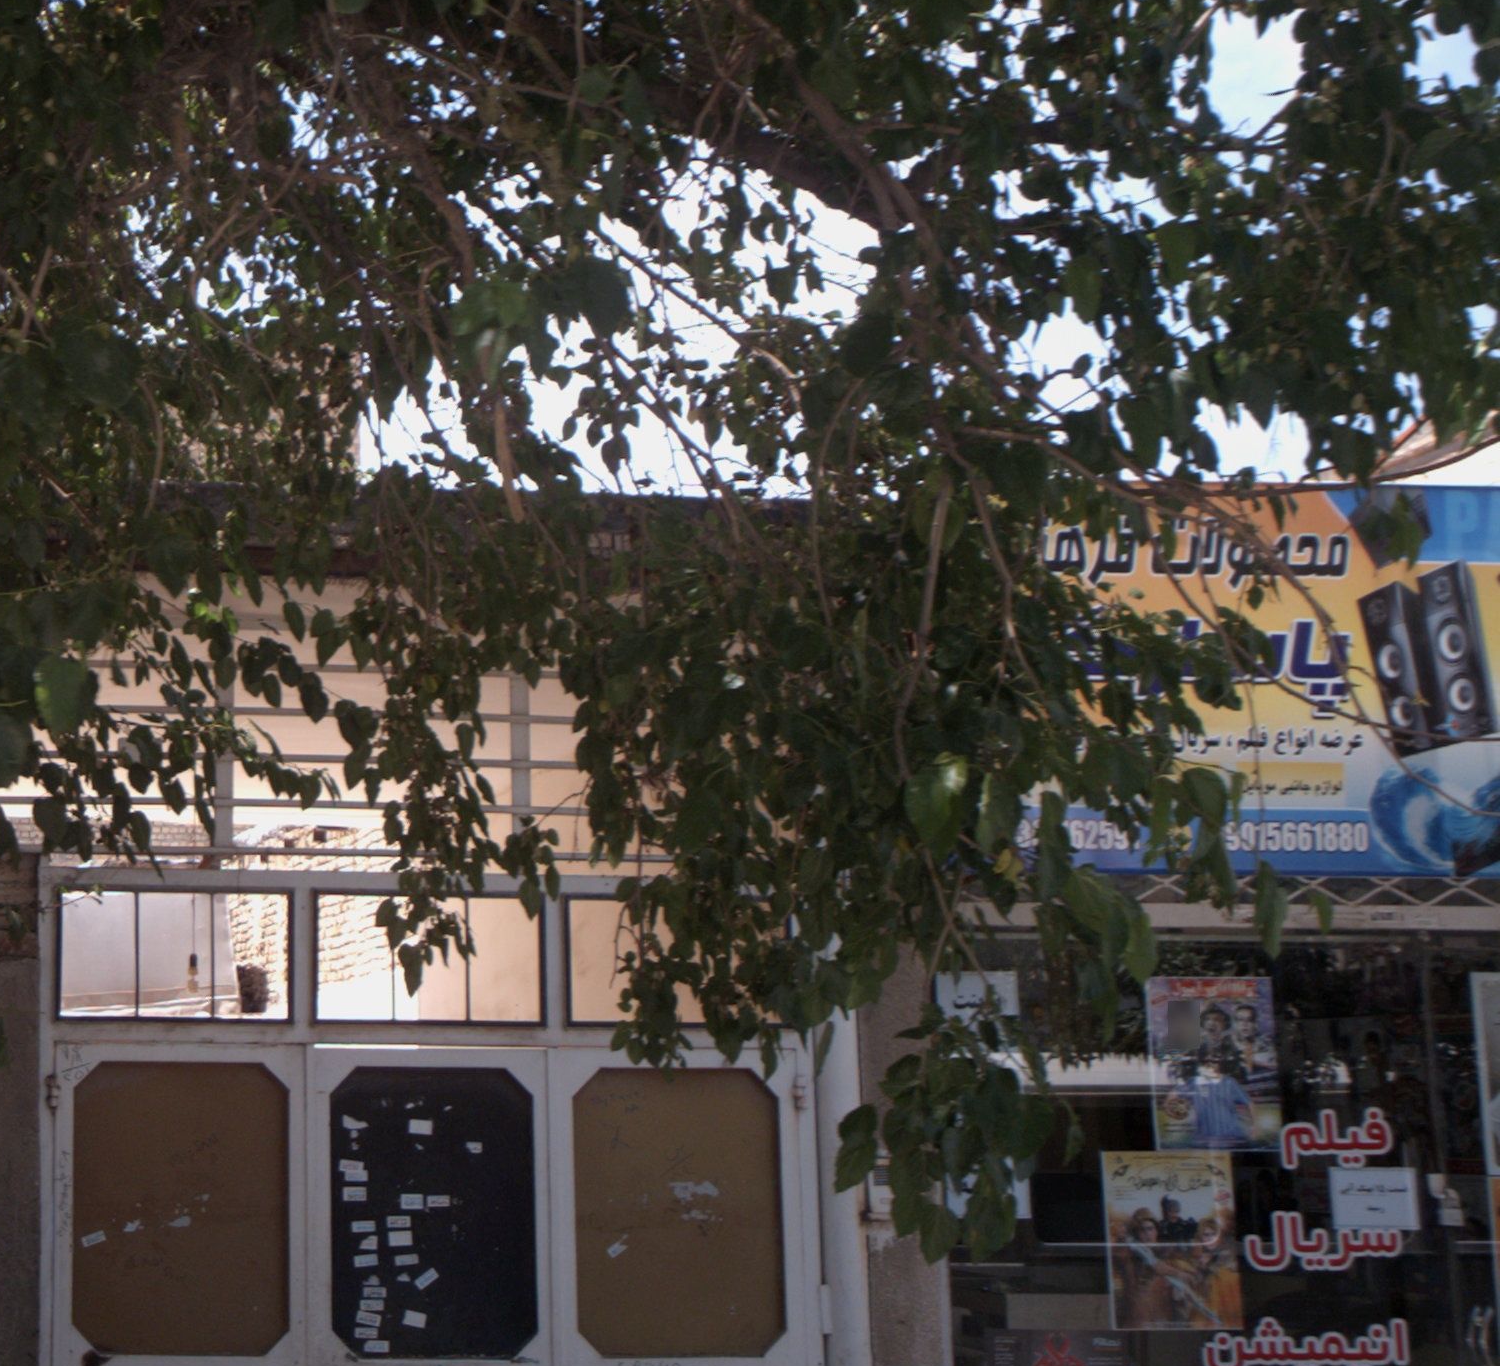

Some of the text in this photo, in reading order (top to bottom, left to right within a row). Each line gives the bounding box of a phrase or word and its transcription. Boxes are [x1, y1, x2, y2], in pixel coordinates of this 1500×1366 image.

[1151, 515, 1350, 588] محصولات
[1237, 726, 1268, 755] فیلم
[1273, 728, 1315, 755] انواع
[1282, 1107, 1394, 1169] فیلم
[1244, 1211, 1401, 1270] سریال
